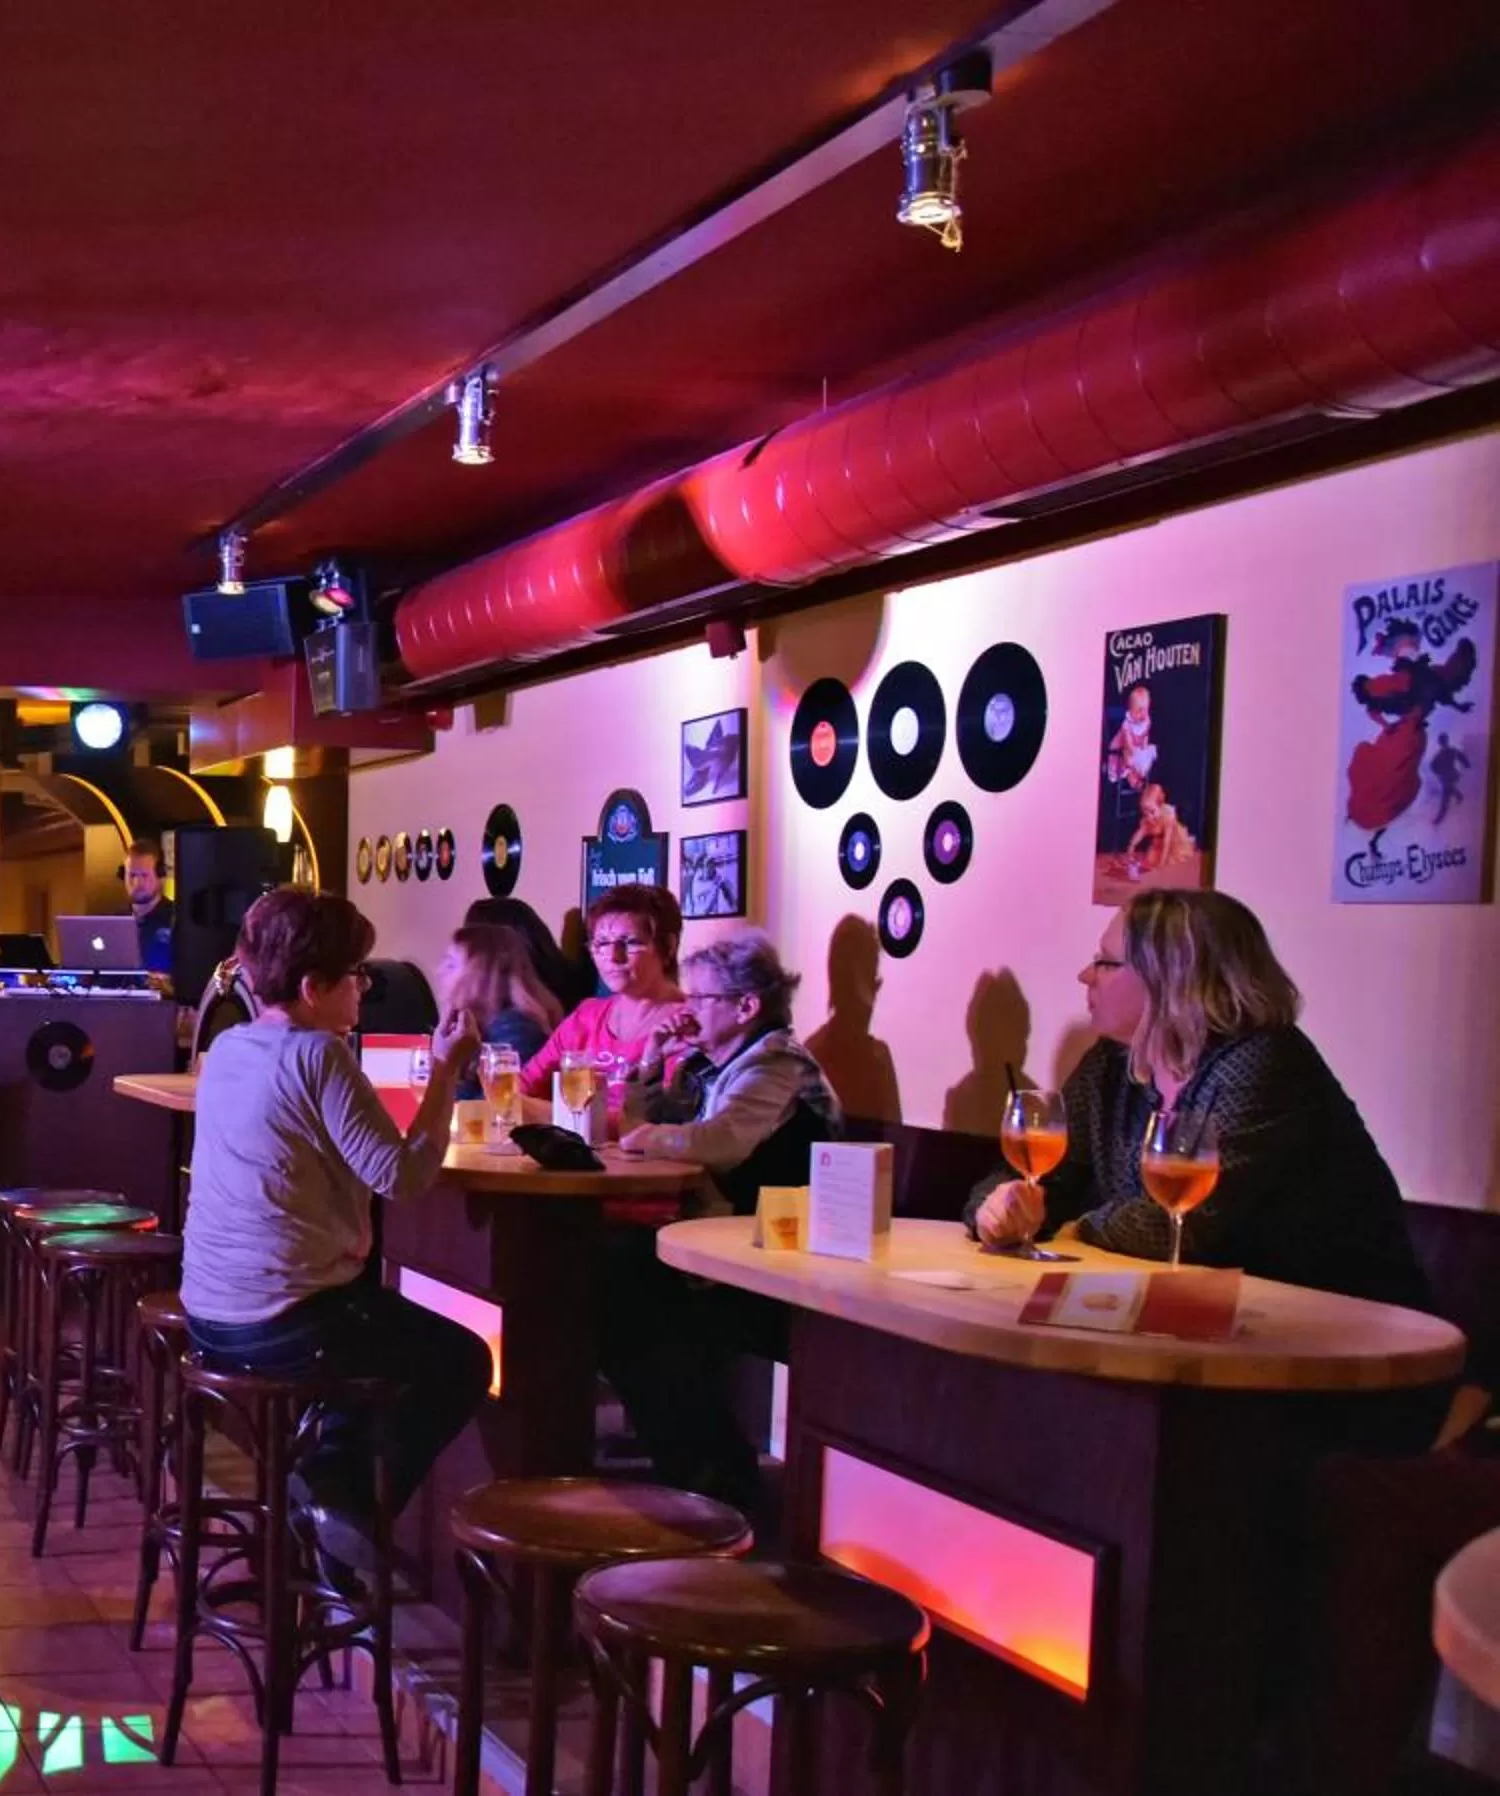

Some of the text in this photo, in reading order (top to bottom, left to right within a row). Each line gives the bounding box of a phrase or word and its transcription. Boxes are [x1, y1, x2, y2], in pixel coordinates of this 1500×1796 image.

[1352, 577, 1445, 656] PALAIS
[1422, 592, 1479, 647] GLACE
[1109, 631, 1153, 657] CACAO
[1113, 642, 1200, 694] VAN HOUTEN
